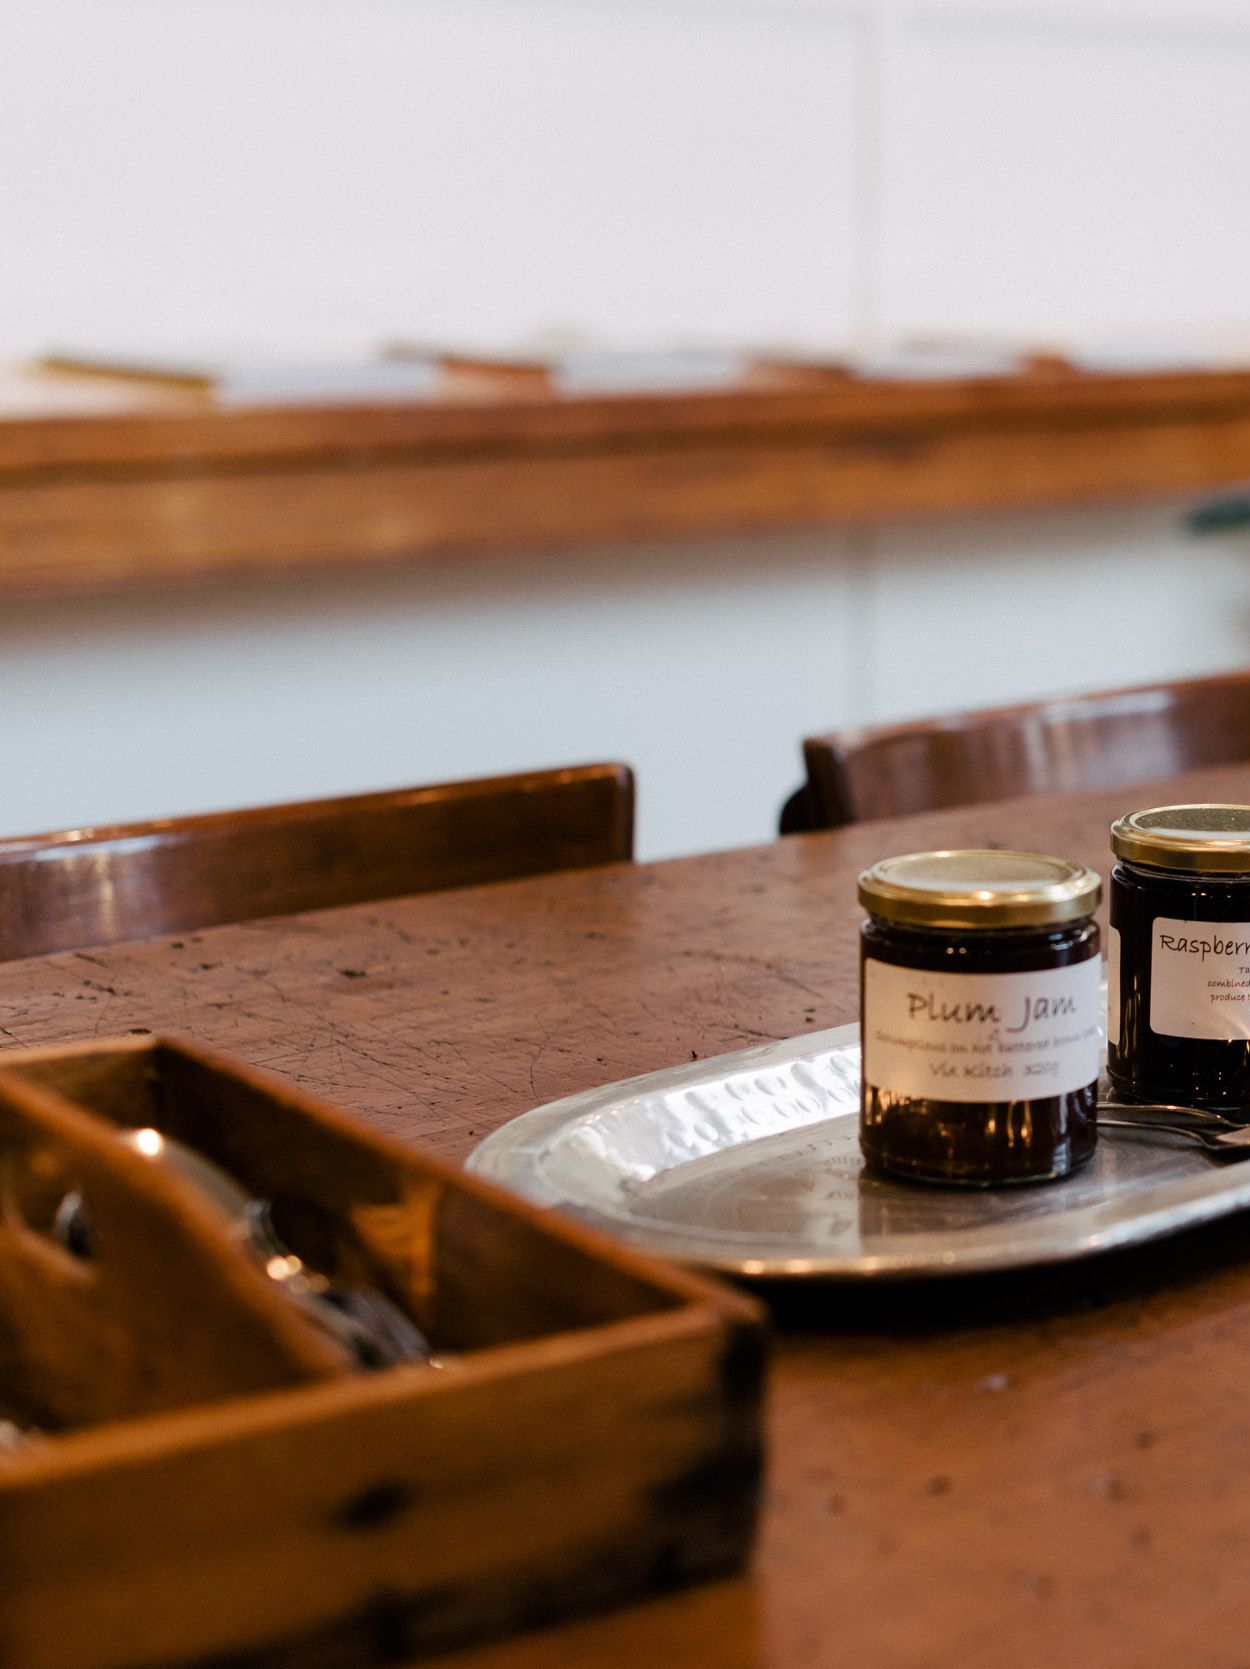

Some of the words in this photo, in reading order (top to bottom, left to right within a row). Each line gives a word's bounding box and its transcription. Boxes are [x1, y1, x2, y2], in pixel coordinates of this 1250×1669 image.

[1207, 978, 1250, 988] combined
[1210, 993, 1245, 1003] produce
[906, 990, 1000, 1024] Plum
[1005, 995, 1077, 1033] Jam
